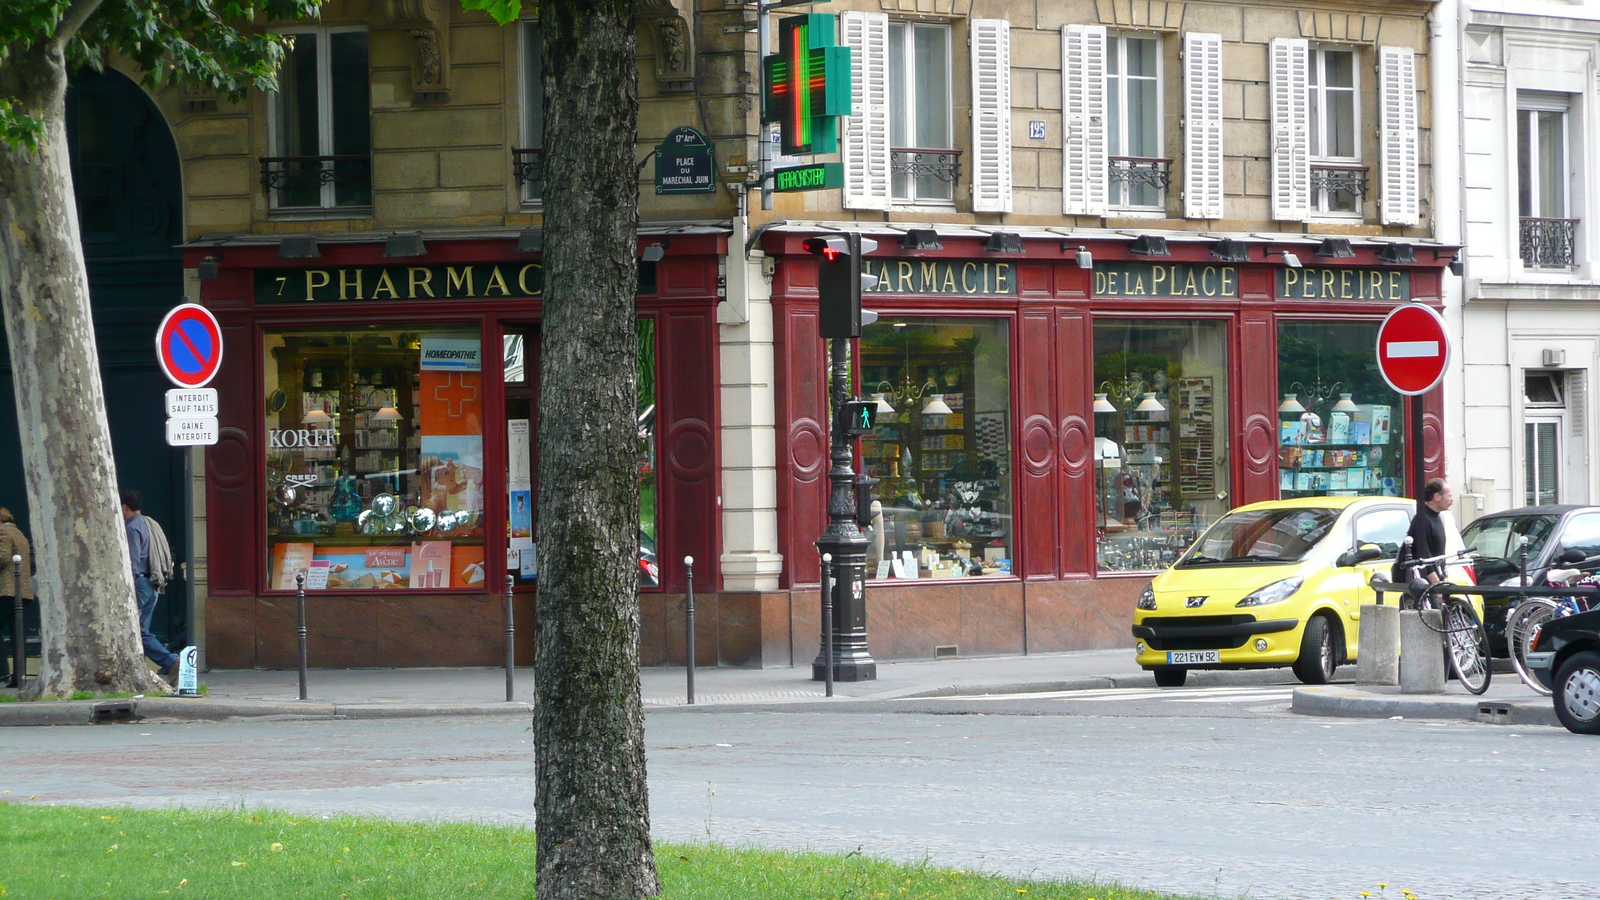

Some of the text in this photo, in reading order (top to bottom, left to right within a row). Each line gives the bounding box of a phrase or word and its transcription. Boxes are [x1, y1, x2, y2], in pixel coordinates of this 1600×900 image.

[1029, 121, 1045, 139] 125
[676, 157, 695, 166] PLACE
[662, 175, 709, 185] MARÉCHAL JUIN
[275, 263, 542, 302] 7 PHARMAC
[864, 260, 1402, 300] ARMACIE DE LA PLACE PEREIRE
[175, 394, 209, 402] INTERDIT
[172, 404, 214, 413] SAUF TAXIS
[181, 422, 204, 430] GAINE
[174, 432, 212, 440] INTERDITE
[268, 429, 336, 448] KORFF
[1174, 652, 1189, 663] 221
[1205, 651, 1216, 662] 92
